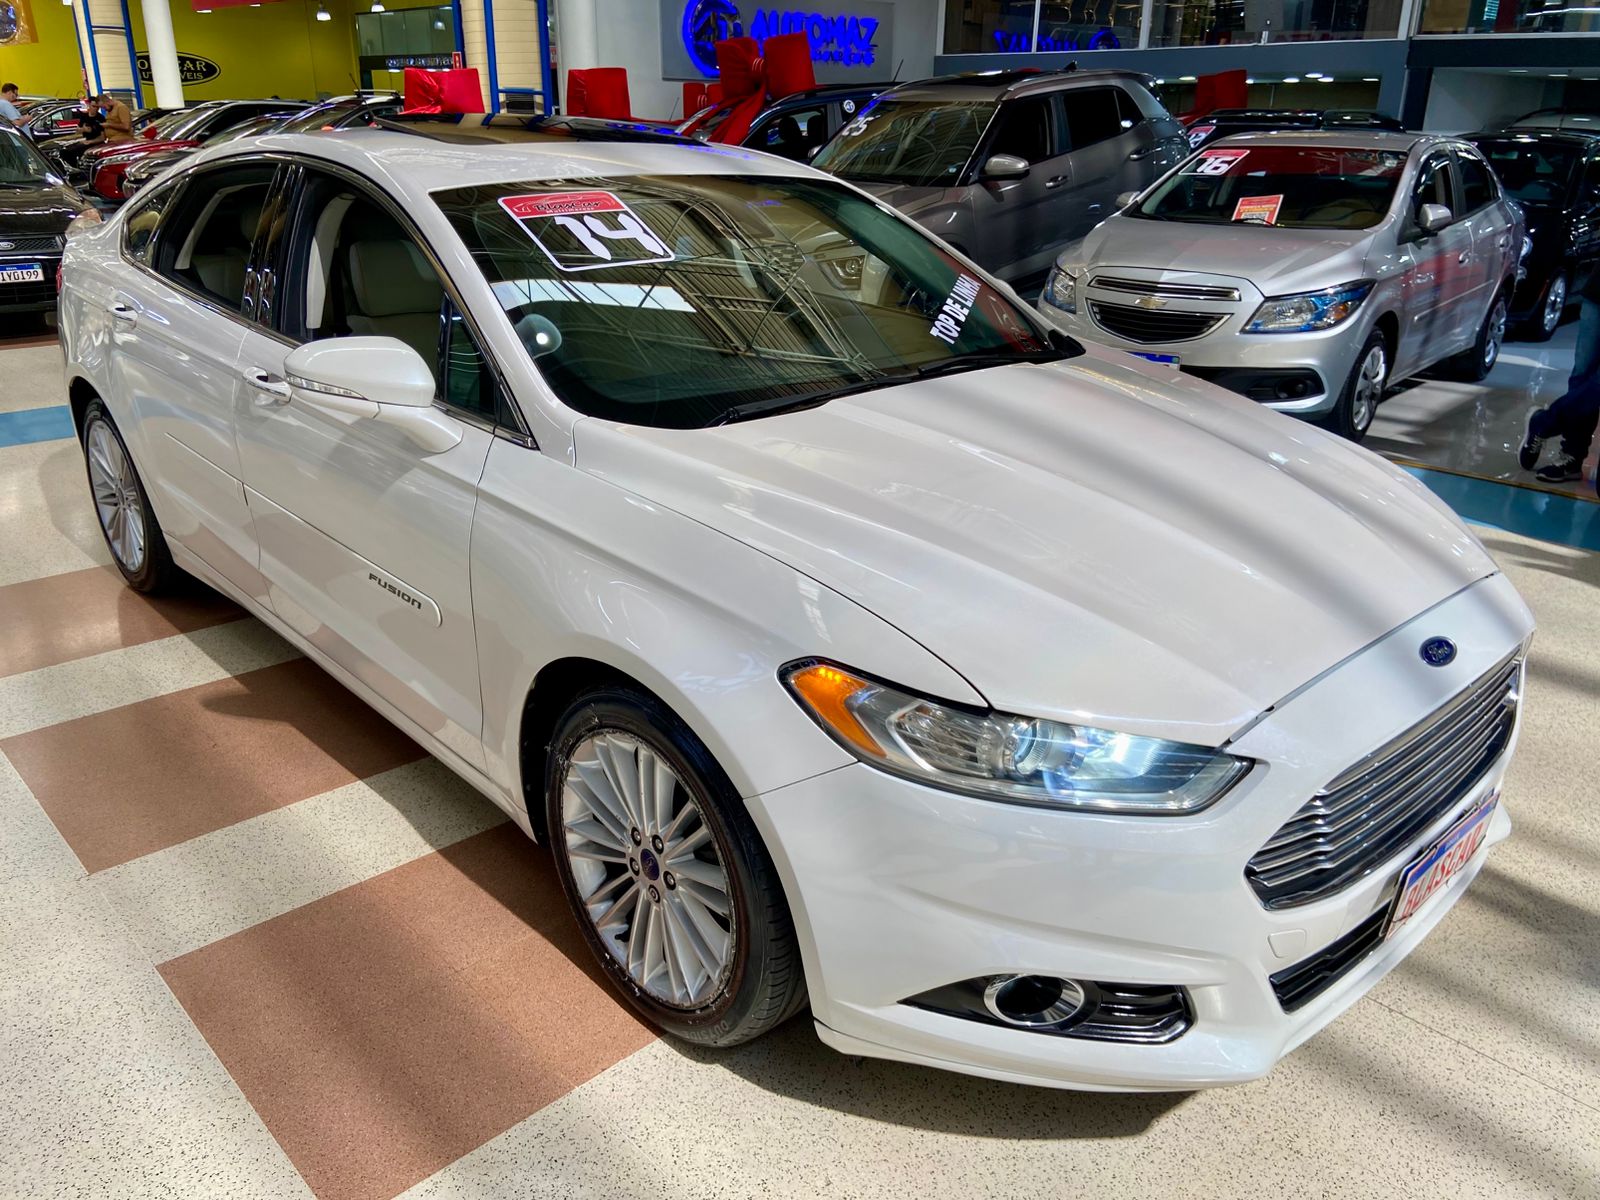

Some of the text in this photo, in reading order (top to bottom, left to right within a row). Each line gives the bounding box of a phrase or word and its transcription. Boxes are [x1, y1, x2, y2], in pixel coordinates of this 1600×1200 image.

[1196, 156, 1236, 173] 16
[553, 212, 665, 262] 14
[929, 273, 982, 345] TOP DE LINHA
[368, 572, 422, 610] FUSION
